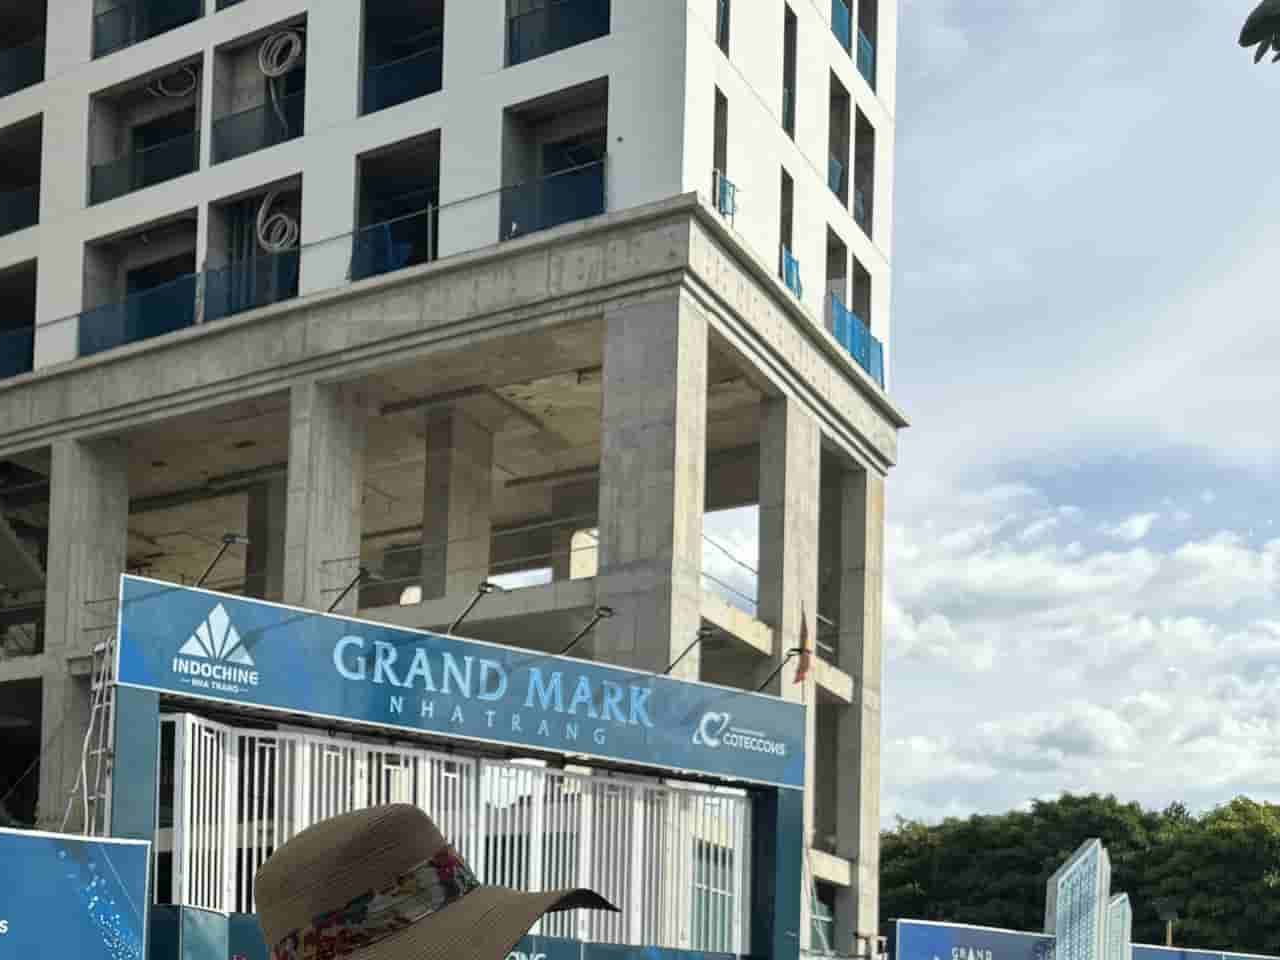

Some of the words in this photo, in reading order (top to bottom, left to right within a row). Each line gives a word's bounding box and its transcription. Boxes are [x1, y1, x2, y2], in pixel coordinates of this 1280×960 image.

[172, 657, 259, 685] INDOCHINE
[332, 635, 508, 702] GRAND
[523, 667, 656, 729] MARK
